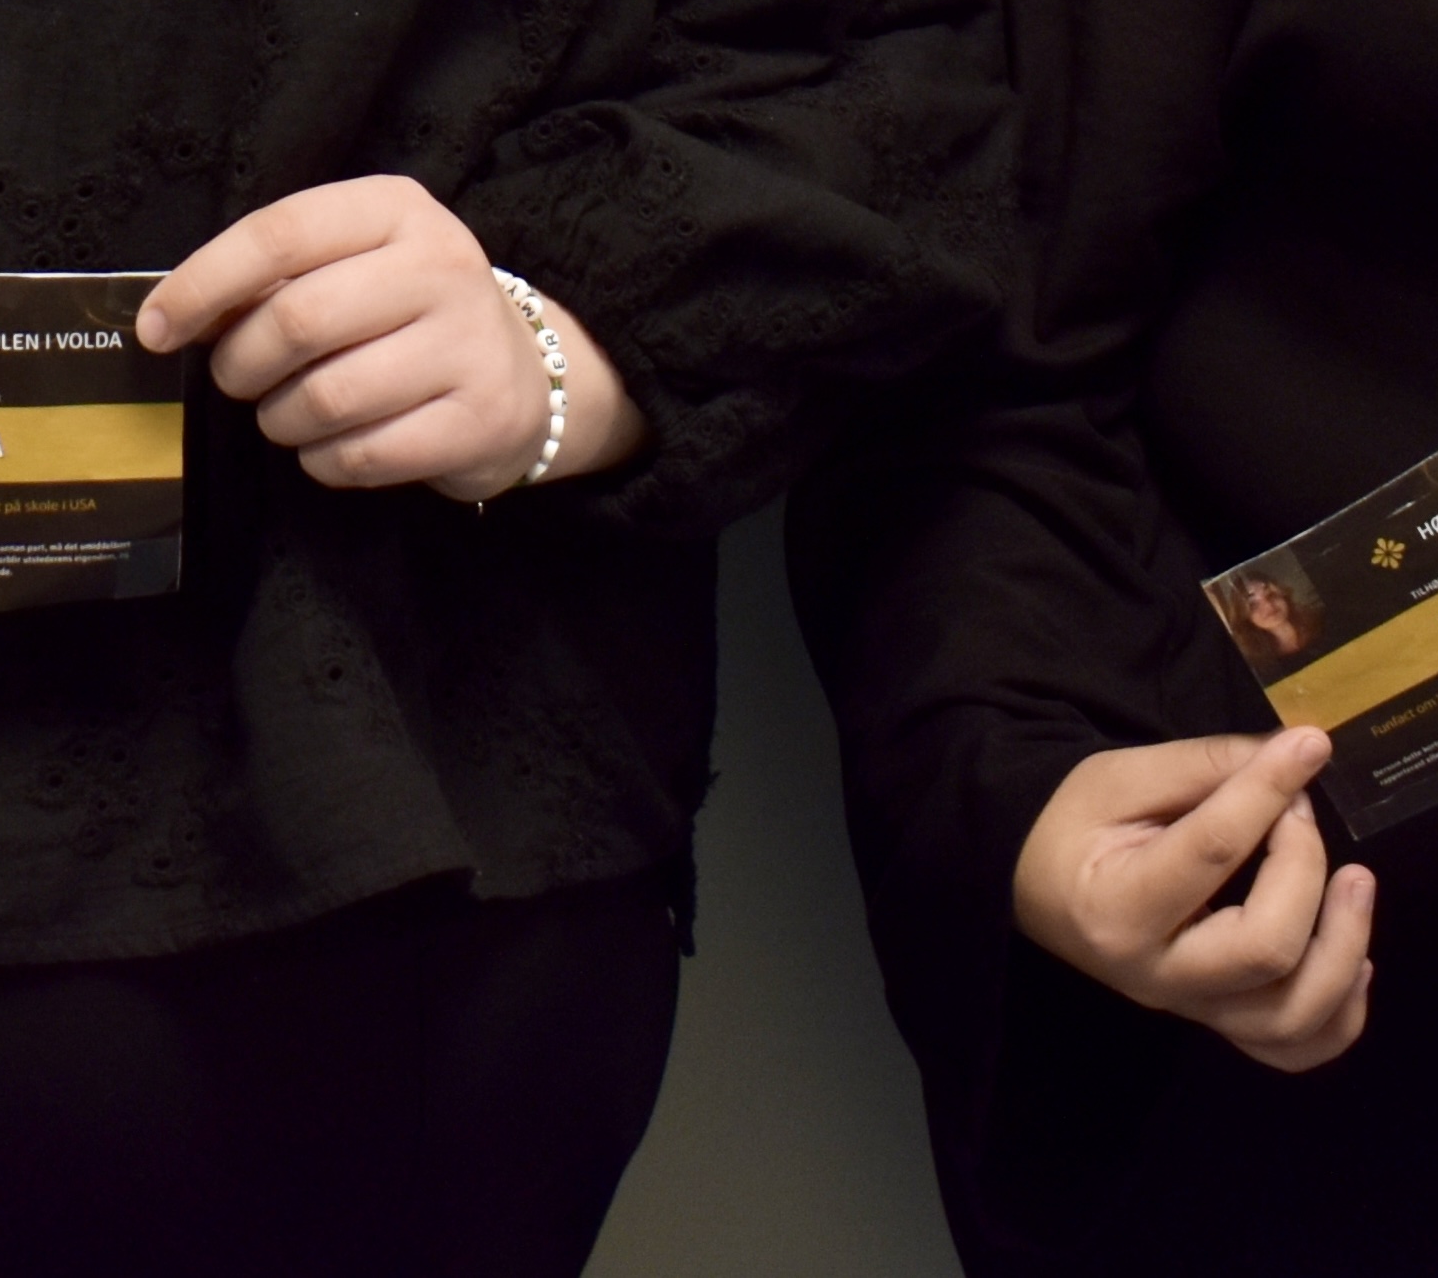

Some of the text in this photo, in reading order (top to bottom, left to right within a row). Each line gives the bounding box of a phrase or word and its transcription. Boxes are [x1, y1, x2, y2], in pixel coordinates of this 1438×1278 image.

[44, 332, 51, 350] I
[55, 331, 123, 350] VOLDA
[3, 499, 22, 515] på
[24, 499, 60, 513] skole
[68, 498, 97, 512] USA
[1370, 708, 1416, 737] Funfact
[1415, 698, 1438, 714] om
